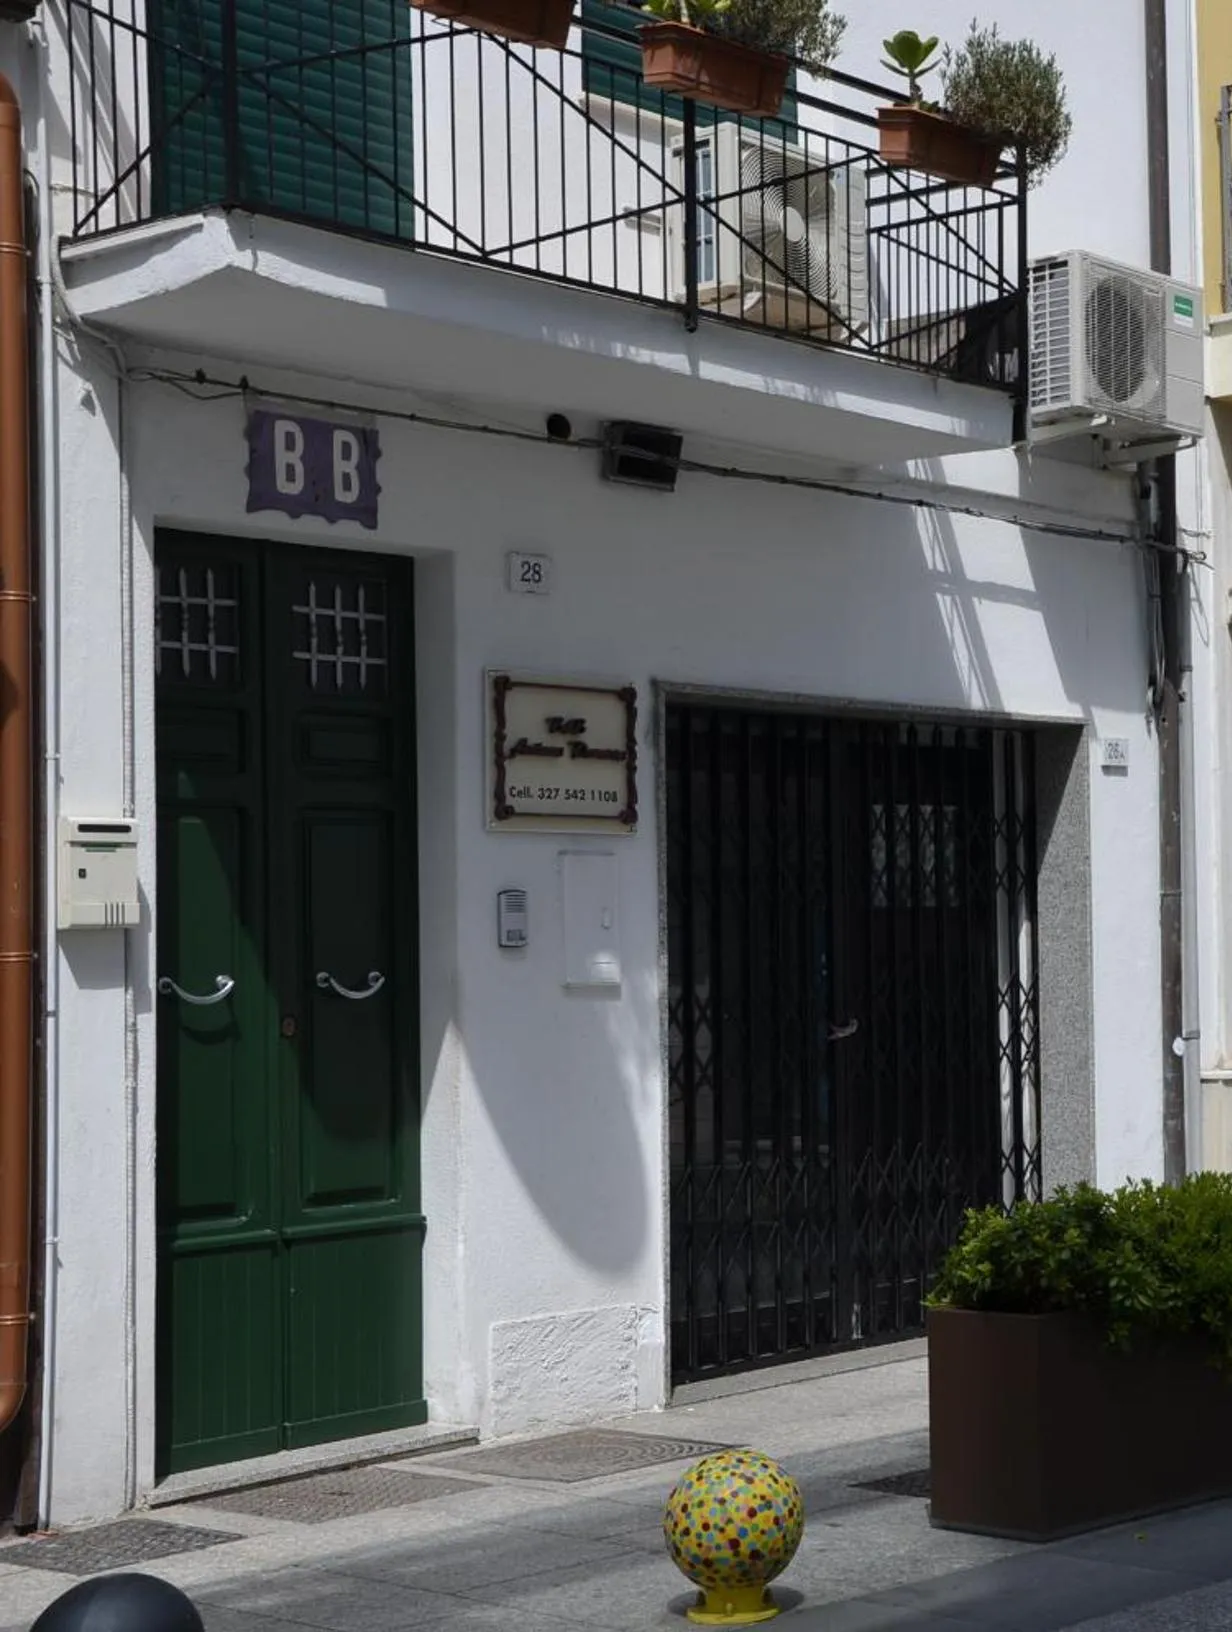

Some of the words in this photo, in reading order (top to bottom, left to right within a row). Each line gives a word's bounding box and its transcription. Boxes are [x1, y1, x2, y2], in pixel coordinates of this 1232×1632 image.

[274, 419, 305, 495] B
[333, 429, 360, 504] B
[520, 560, 542, 584] 28
[537, 787, 561, 801] 327
[564, 789, 586, 801] 542
